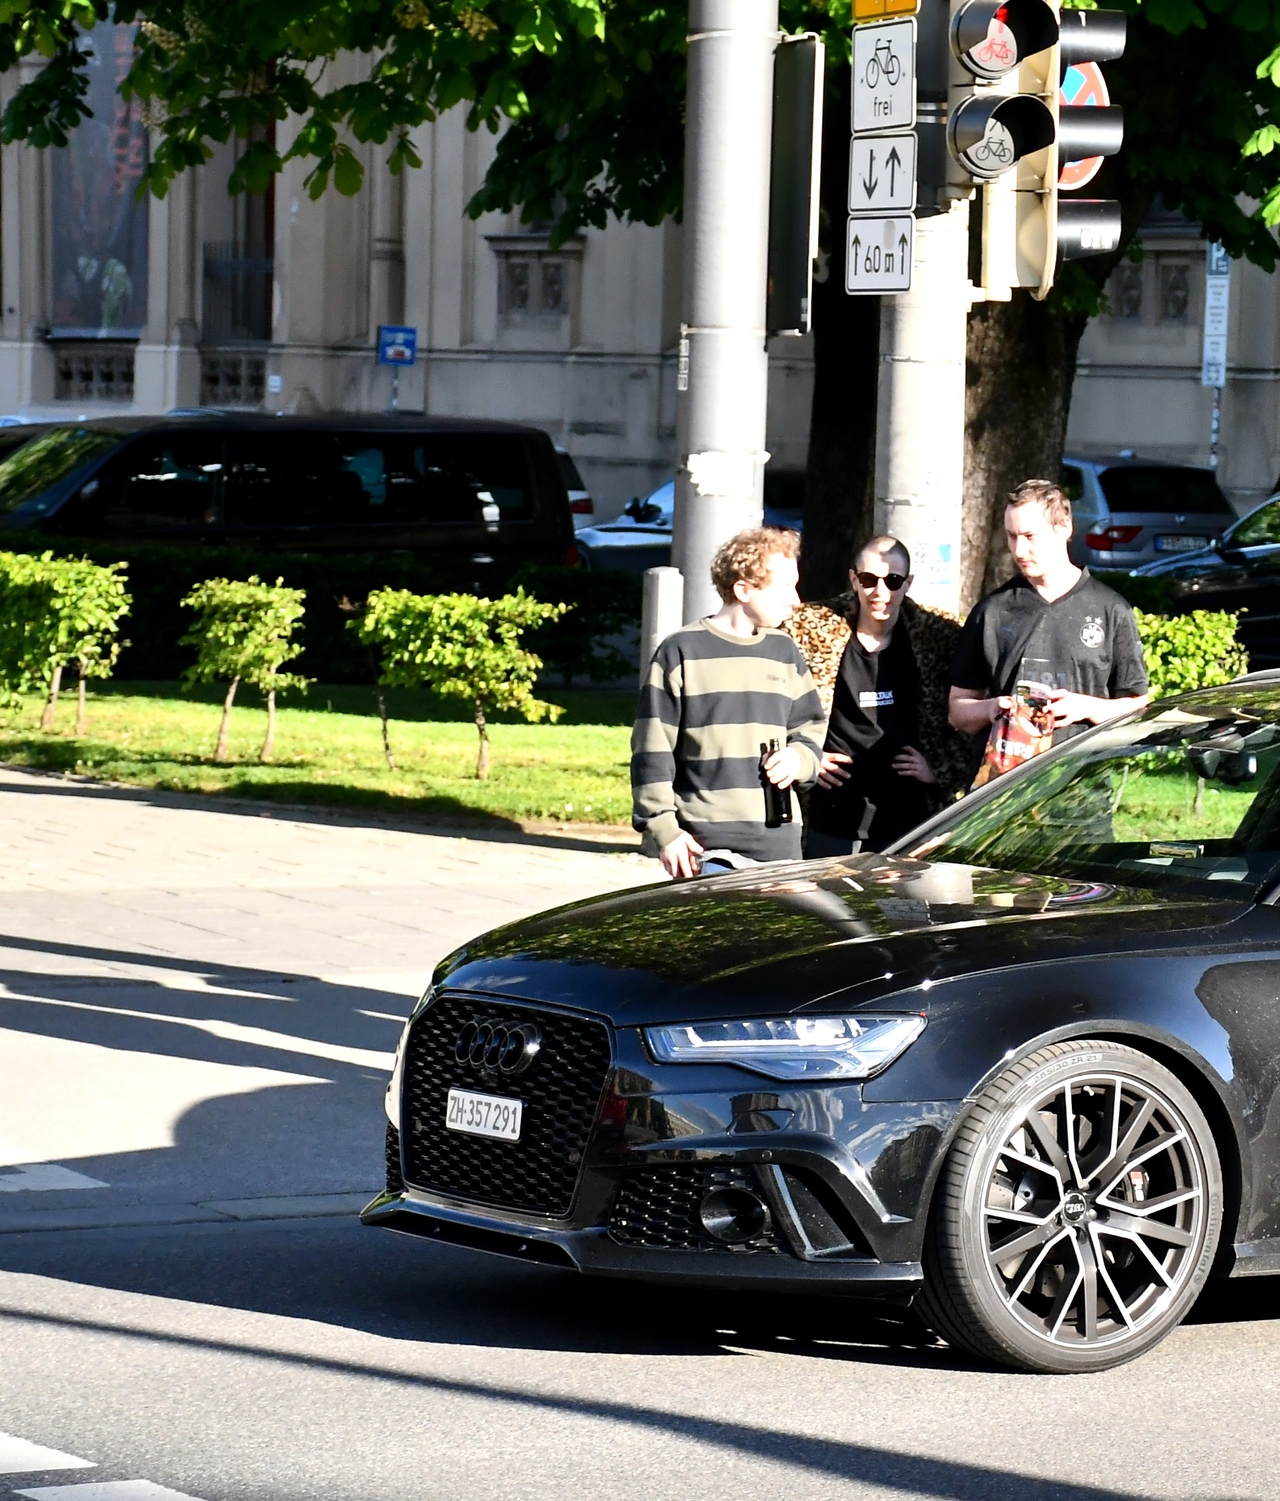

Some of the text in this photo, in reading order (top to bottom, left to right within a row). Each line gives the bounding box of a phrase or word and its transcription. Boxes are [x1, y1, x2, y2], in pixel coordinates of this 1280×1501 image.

[873, 94, 893, 117] frei
[864, 245, 895, 273] 60 m
